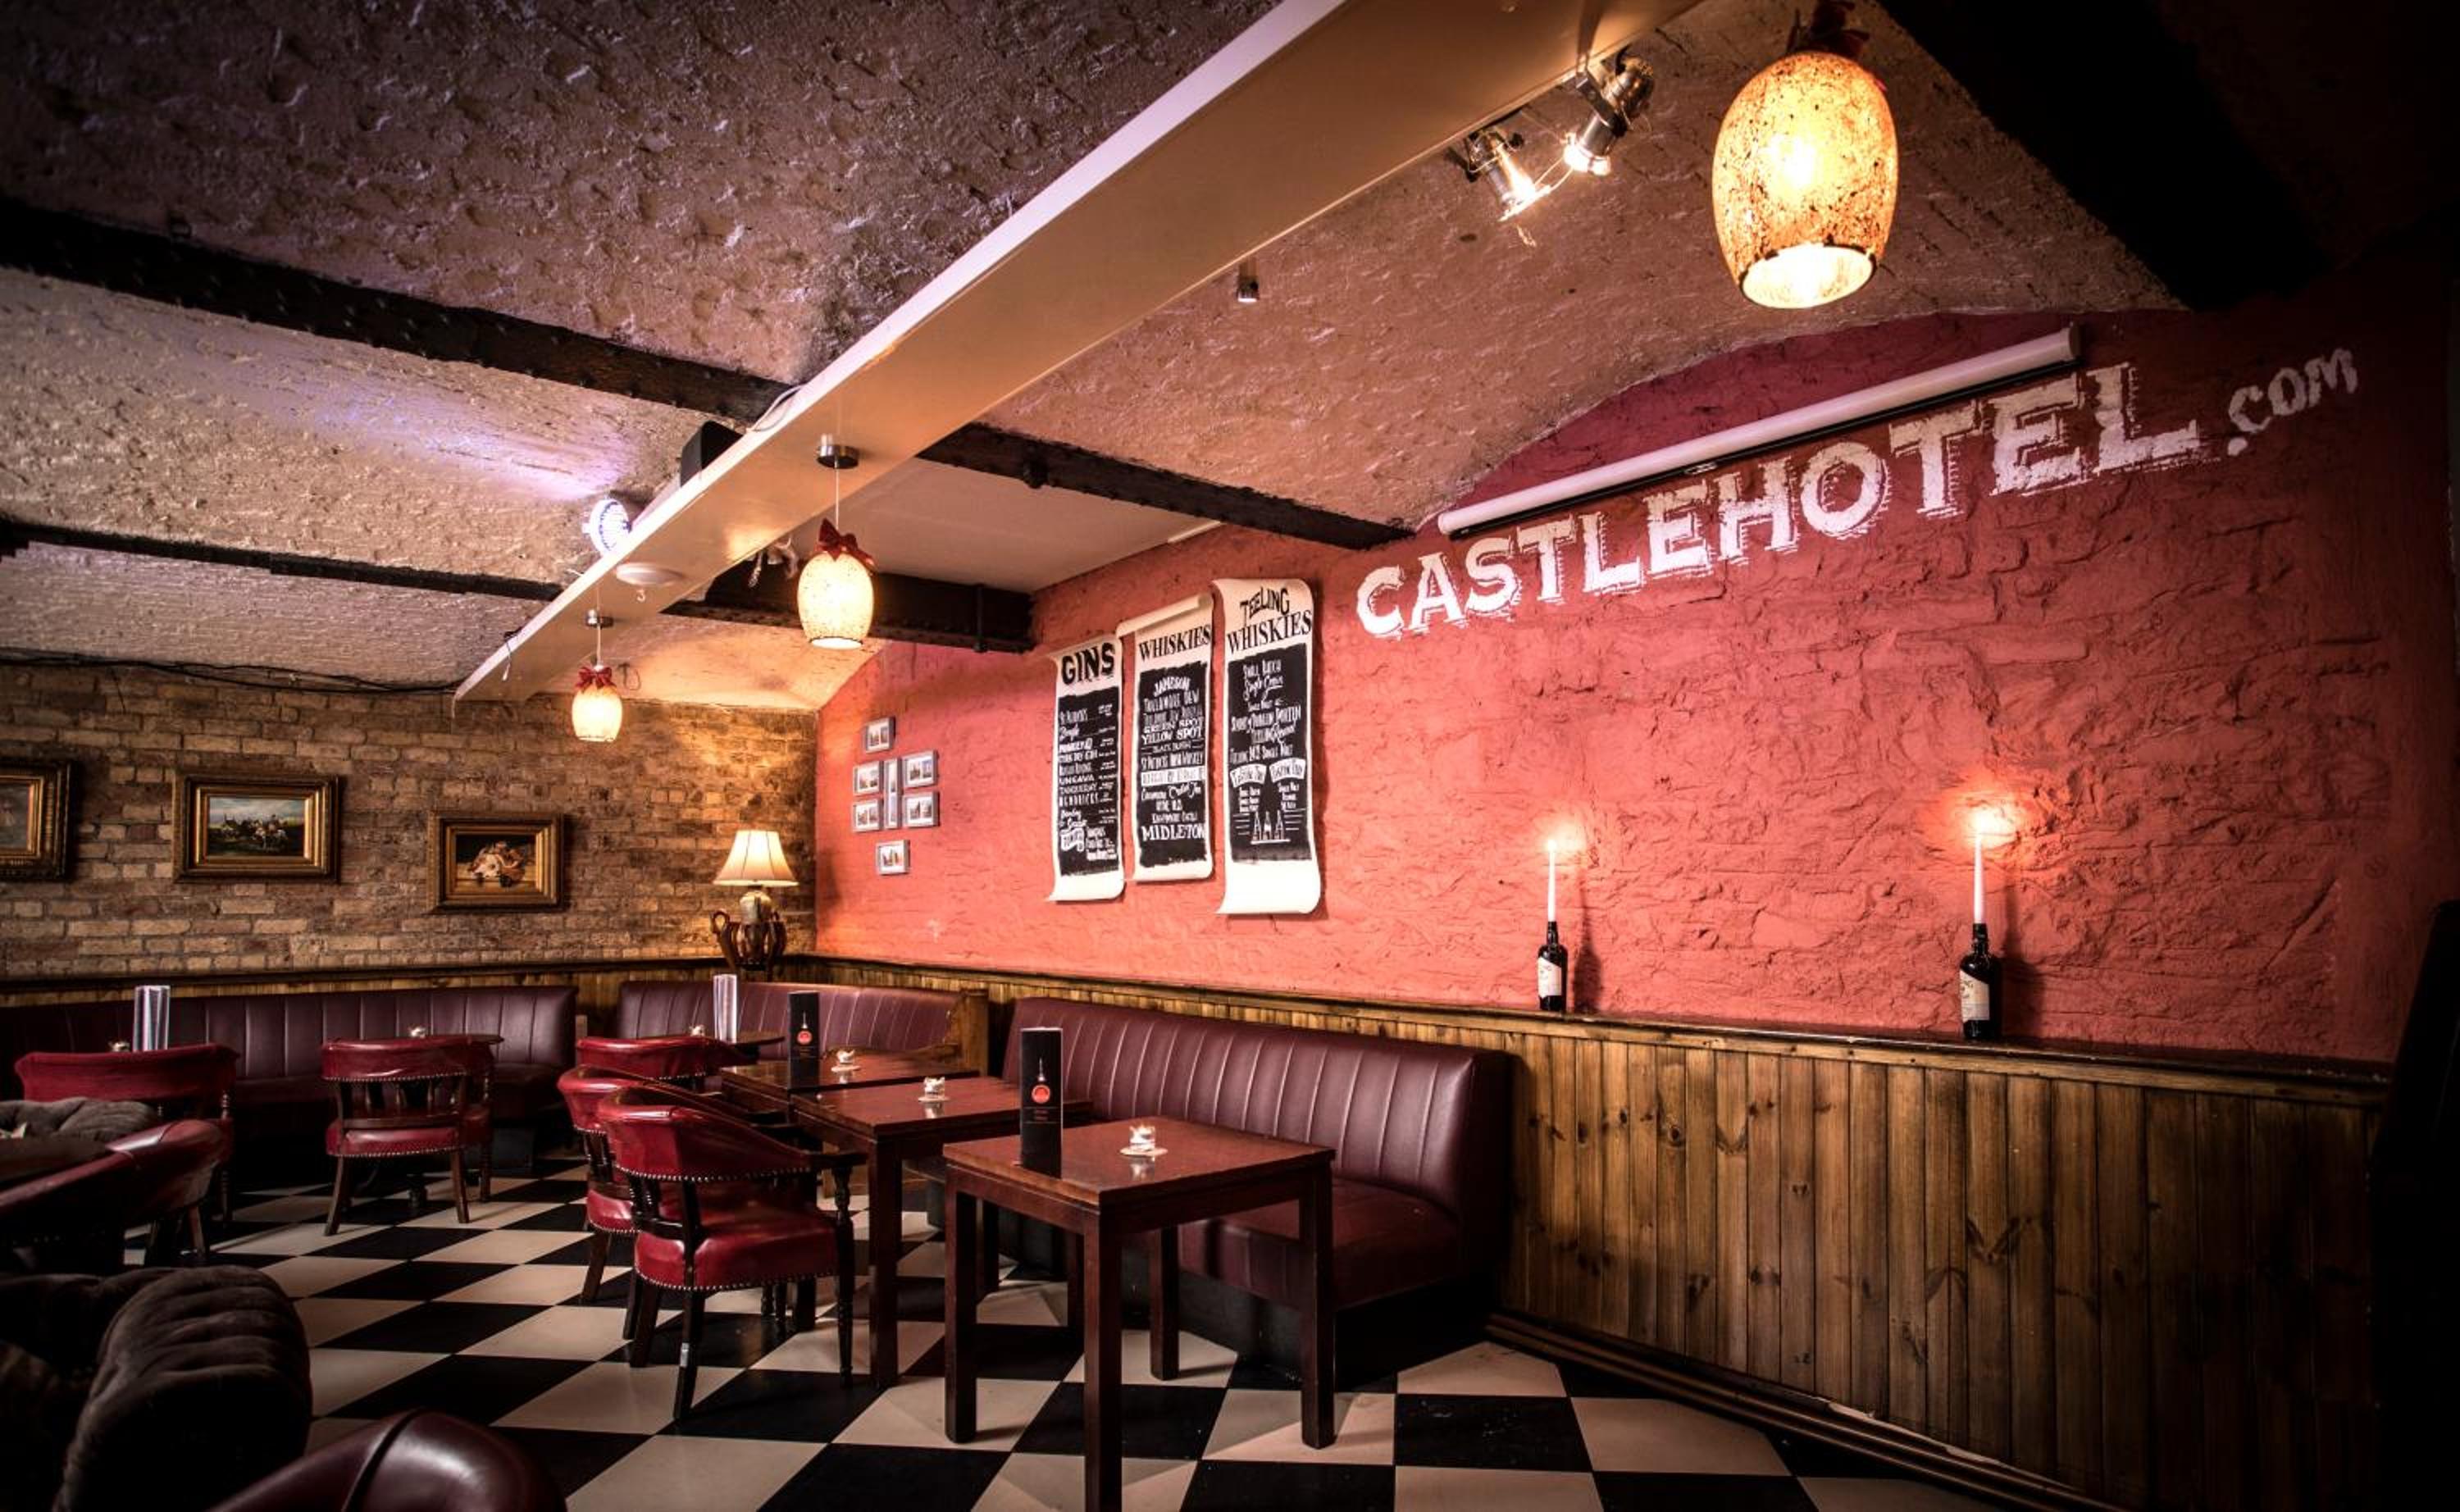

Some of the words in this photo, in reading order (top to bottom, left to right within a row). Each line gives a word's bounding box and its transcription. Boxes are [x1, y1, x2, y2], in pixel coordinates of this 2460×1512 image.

[1240, 586, 1290, 626] TEELING
[1138, 624, 1211, 662] WHISKIES
[1227, 609, 1312, 654] WHISKIES
[1061, 642, 1115, 685] GINS
[1141, 823, 1205, 842] MIDLETON
